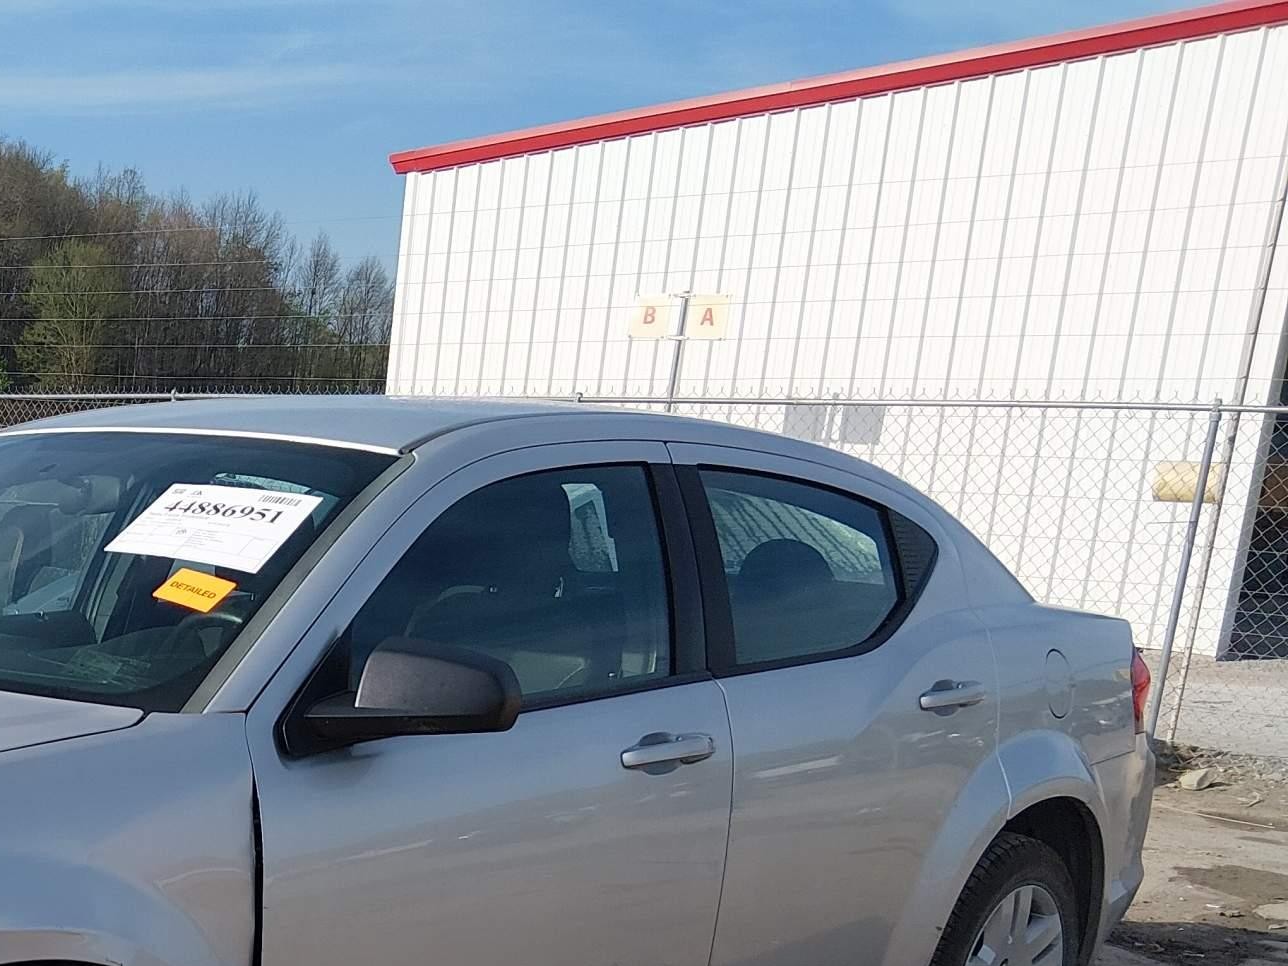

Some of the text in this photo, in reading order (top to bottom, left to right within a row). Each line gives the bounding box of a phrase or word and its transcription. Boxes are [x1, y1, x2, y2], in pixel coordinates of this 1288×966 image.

[642, 306, 657, 325] B
[700, 307, 714, 326] A
[164, 499, 285, 524] 44886951
[169, 580, 217, 600] DETAILED
